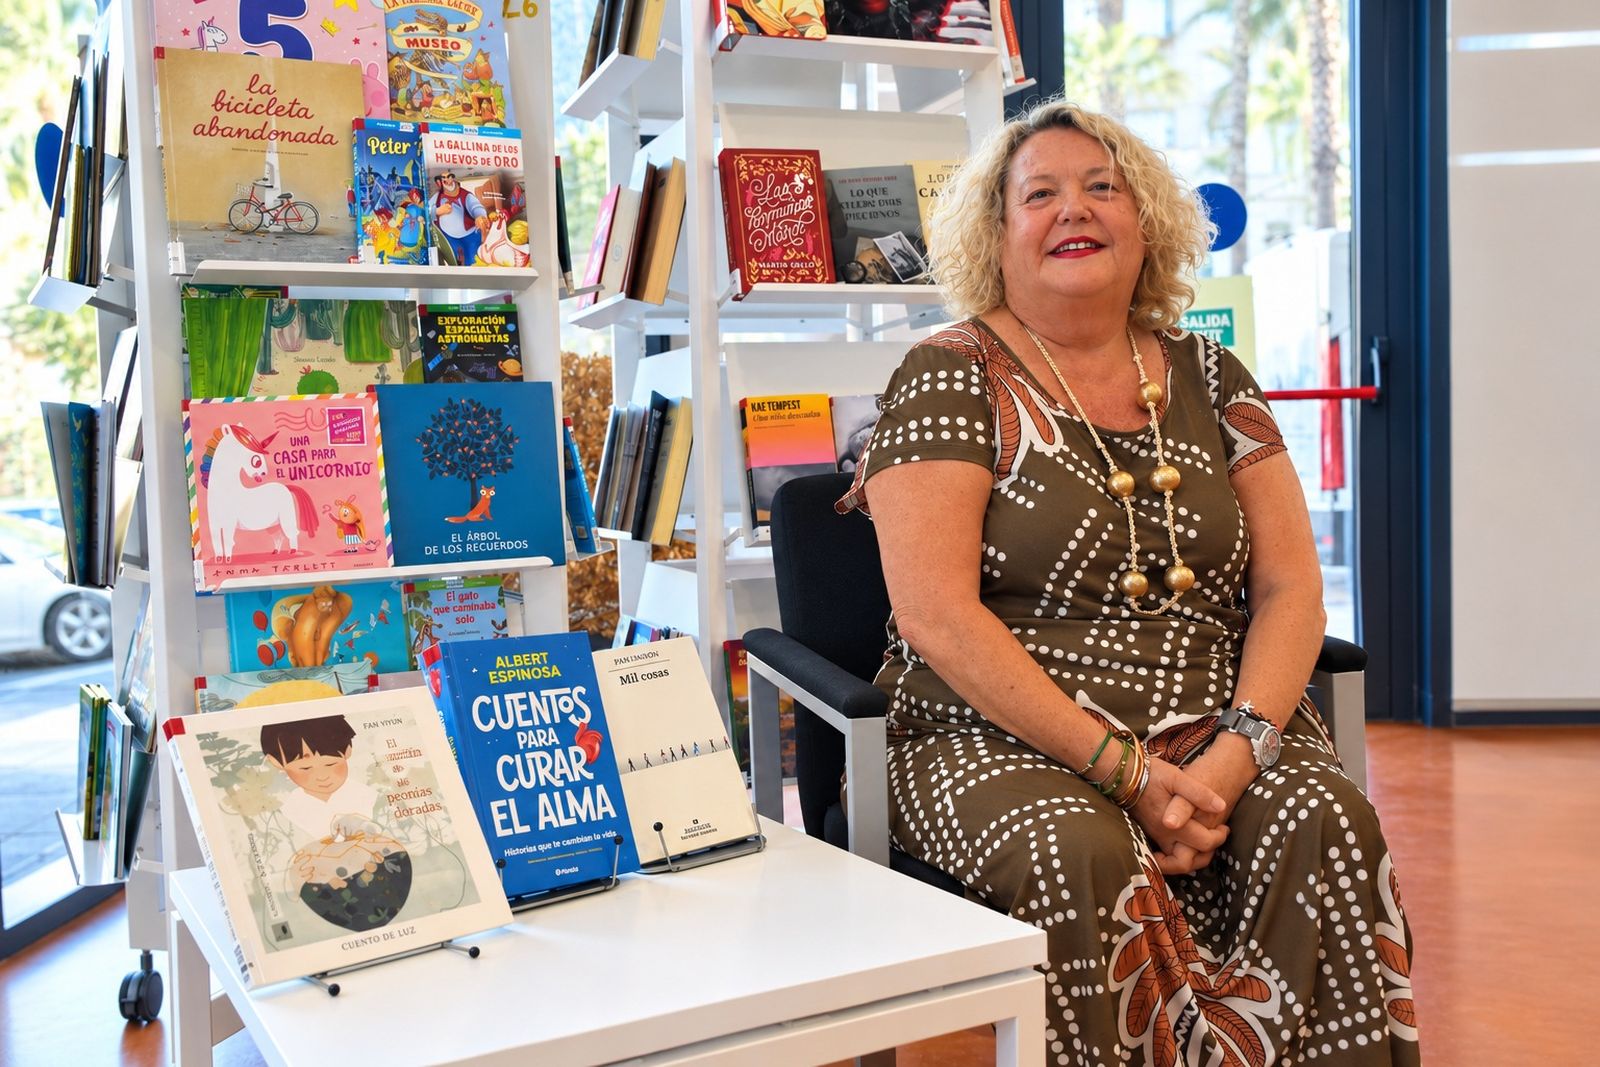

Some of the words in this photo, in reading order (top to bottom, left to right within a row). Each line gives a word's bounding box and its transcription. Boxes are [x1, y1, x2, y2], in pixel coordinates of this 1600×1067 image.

[405, 38, 461, 50] MUSEO
[246, 74, 276, 95] la
[211, 89, 314, 119] bicicleta
[193, 116, 339, 145] abandonada
[367, 136, 411, 155] Peter
[434, 139, 445, 149] LA
[447, 140, 490, 153] GALLINA
[492, 142, 502, 153] DE
[503, 143, 519, 154] LOS
[435, 153, 478, 165] HUEVOS
[480, 157, 491, 167] DE
[493, 155, 519, 168] ORO
[866, 187, 889, 198] QUE
[437, 314, 506, 325] EXPLORACIÓN
[1180, 313, 1231, 328] SALIDA
[495, 325, 500, 335] Y
[437, 334, 510, 344] ASTRONAUTAS
[751, 401, 766, 412] KAE
[767, 400, 801, 411] TEMPEST
[290, 436, 310, 447] UNA
[274, 449, 307, 464] CASA
[311, 449, 336, 460] PARA
[276, 468, 285, 478] EL
[289, 461, 373, 480] UNICORNIO
[451, 533, 463, 543] EL
[467, 530, 501, 541] ÁRBOL
[424, 546, 439, 556] DE
[442, 544, 463, 554] LOS
[466, 540, 529, 553] RECUERDOS
[446, 591, 456, 602] El
[458, 591, 480, 603] gato
[433, 605, 450, 616] que
[452, 600, 497, 613] caminaba
[455, 614, 475, 625] solo
[495, 652, 549, 669] ALBERT
[488, 665, 562, 684] ESPINOSA
[620, 672, 639, 686] Mil
[641, 669, 670, 681] cosas
[471, 685, 592, 732] CUENTOS
[363, 721, 379, 730] FAN
[386, 738, 397, 749] El
[516, 727, 560, 750] PARA
[496, 745, 594, 792] CURAR
[394, 801, 443, 819] doradas
[490, 798, 531, 837] EL
[538, 784, 617, 831] ALMA
[504, 845, 537, 857] Historias
[537, 843, 552, 853] que
[553, 840, 561, 848] te
[562, 835, 593, 846] cambian
[593, 833, 601, 841] la
[601, 830, 617, 839] vida
[341, 935, 381, 951] CUENTO
[382, 931, 396, 941] DE
[398, 926, 417, 938] LUZ
